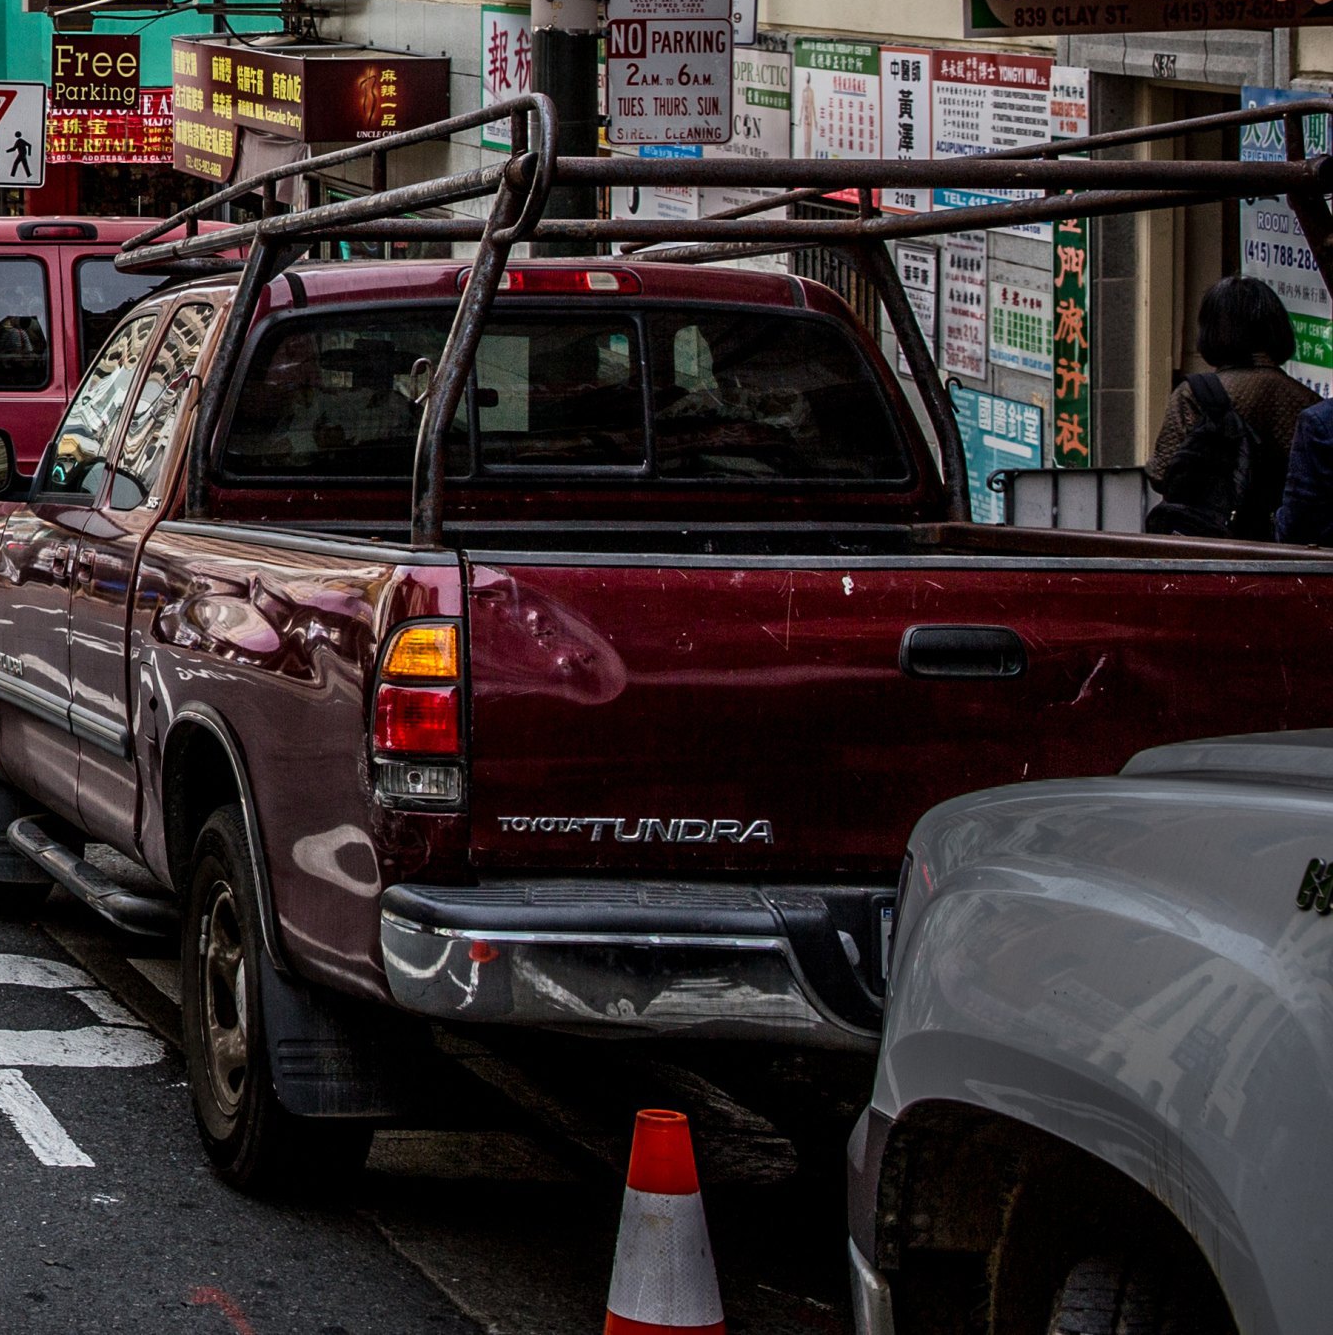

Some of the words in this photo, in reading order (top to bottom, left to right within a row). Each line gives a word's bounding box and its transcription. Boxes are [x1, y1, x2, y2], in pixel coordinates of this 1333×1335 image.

[1014, 7, 1046, 27] 839
[1052, 6, 1100, 26] CLAY
[1105, 5, 1132, 25] ST.
[1162, 3, 1209, 25] (415)
[611, 23, 643, 54] NO
[651, 30, 725, 53] PARKING
[55, 45, 137, 77] Free
[665, 78, 674, 86] TO
[999, 66, 1025, 83] YONGYI
[1026, 68, 1037, 84] WU
[55, 83, 136, 105] Parking
[380, 69, 397, 127] 麻辣一品
[618, 97, 647, 116] TUES.
[653, 97, 691, 116] THURS.
[697, 96, 722, 116] SUN.
[1257, 212, 1288, 233] ROOM
[1244, 239, 1270, 268] (415)
[498, 817, 583, 832] TOYOTA
[583, 818, 774, 844] TUNDRA
